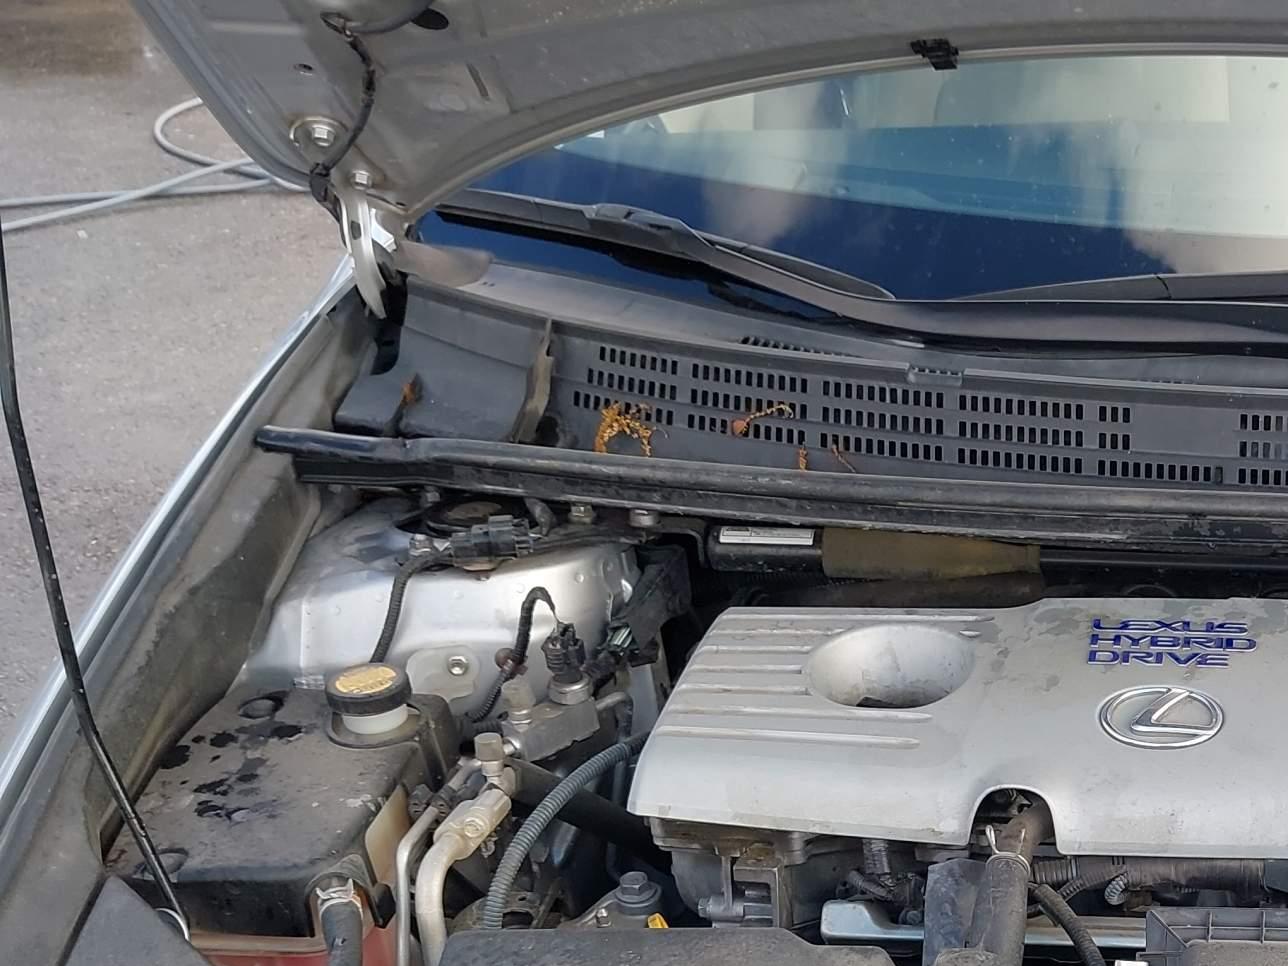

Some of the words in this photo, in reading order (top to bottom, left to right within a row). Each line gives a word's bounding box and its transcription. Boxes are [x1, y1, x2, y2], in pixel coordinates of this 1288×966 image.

[1092, 618, 1249, 635] LEXUS
[1088, 633, 1258, 652] HYBRID
[1087, 650, 1231, 668] DRIVE
